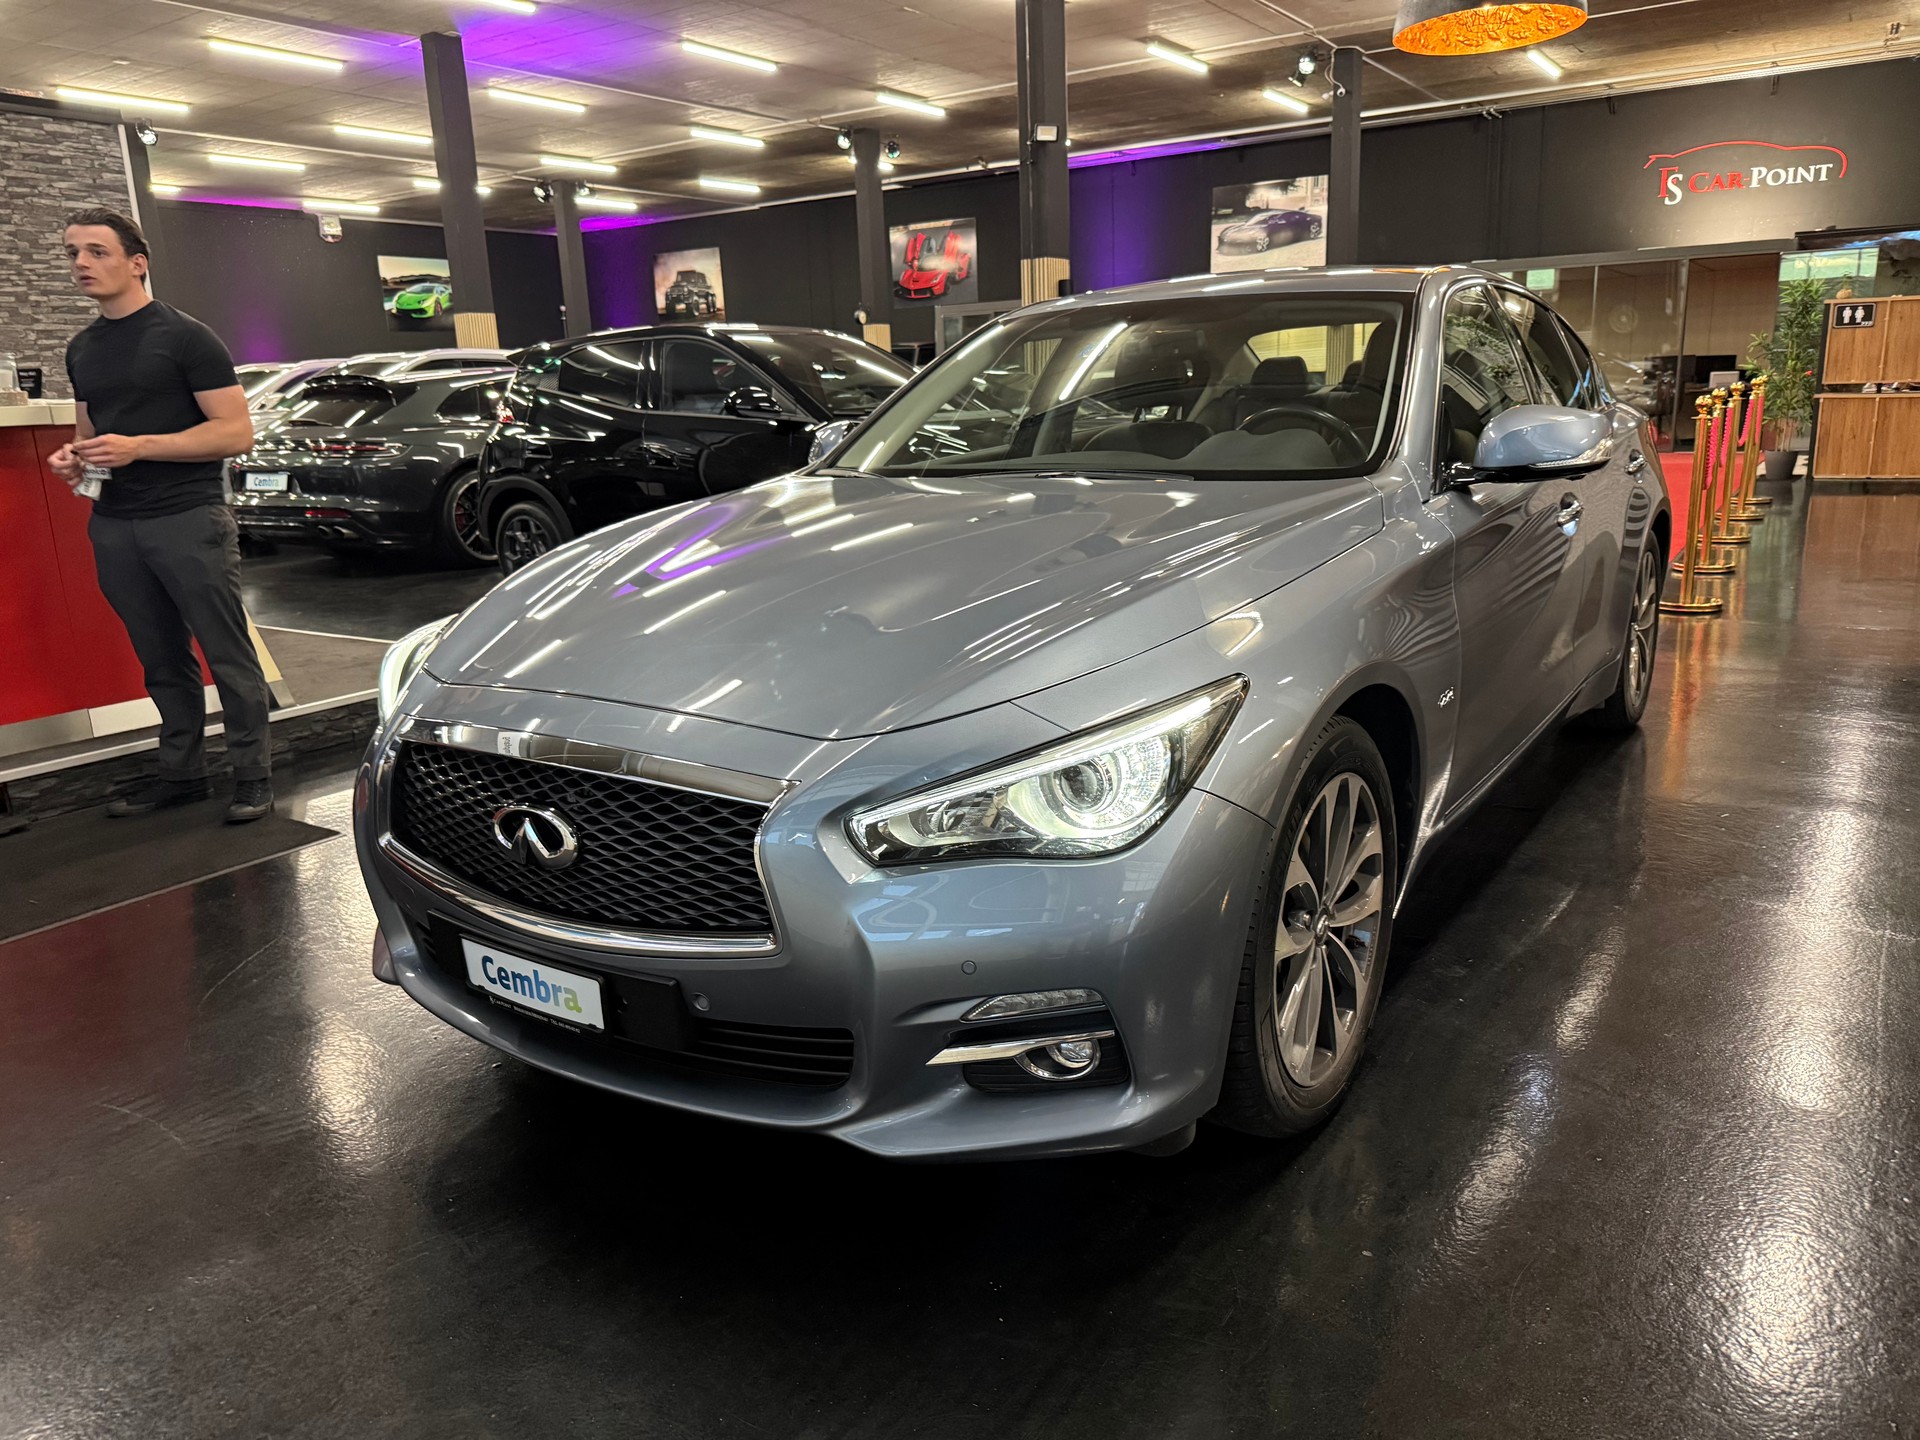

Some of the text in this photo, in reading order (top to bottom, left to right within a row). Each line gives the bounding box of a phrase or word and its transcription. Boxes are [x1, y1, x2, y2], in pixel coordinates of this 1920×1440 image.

[1688, 163, 1834, 193] CAR-POINT
[253, 476, 280, 488] Cembra
[481, 955, 583, 1014] Cembra
